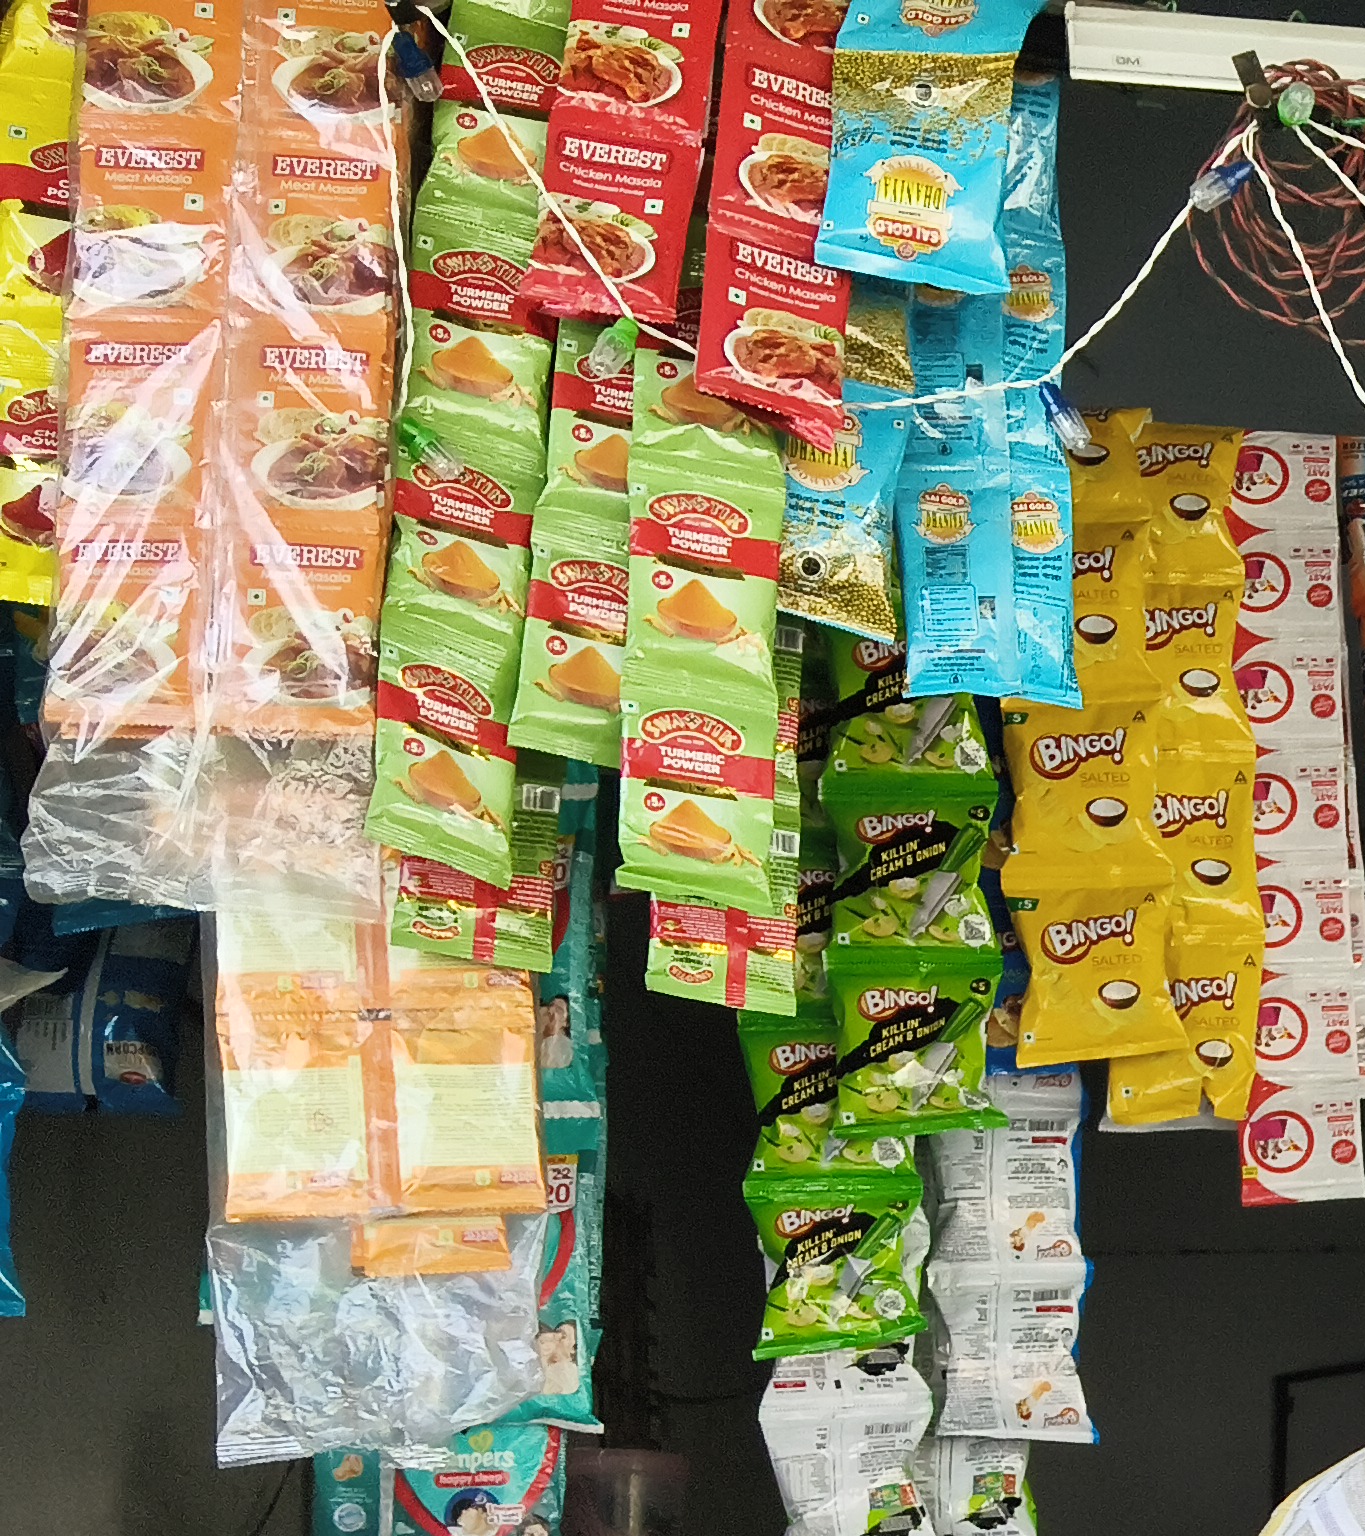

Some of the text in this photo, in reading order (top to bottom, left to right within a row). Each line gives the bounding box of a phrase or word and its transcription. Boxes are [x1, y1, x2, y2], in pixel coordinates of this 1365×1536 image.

[906, 9, 936, 22] GOLD
[481, 74, 545, 95] TURMERIC
[482, 85, 540, 102] POWDER
[749, 94, 802, 119] Chicken
[98, 148, 202, 171] EVEREST
[561, 137, 668, 172] EVEREST
[104, 171, 192, 186] Meat Masala
[274, 156, 378, 180] EVEREST
[559, 160, 663, 189] Chicken Masala
[279, 180, 368, 195] Meat Masala
[874, 218, 909, 237] GOLD
[735, 243, 838, 286] EVEREST
[450, 283, 515, 304] TURMERIC
[734, 267, 837, 304] Chicken Masala
[452, 294, 510, 313] POWDER
[88, 343, 190, 365] EVEREST
[263, 347, 367, 370] EVEREST
[429, 491, 496, 520] TURMERIC
[432, 504, 492, 527] POWDER
[666, 527, 733, 548] TURMERIC
[670, 539, 729, 556] POWDER
[77, 541, 180, 562] EVEREST
[254, 545, 360, 568] EVEREST
[417, 696, 480, 724] TURMERIC
[419, 706, 478, 733] POWDER
[658, 744, 726, 766] TURMERIC
[1037, 727, 1126, 770] BINGO!
[663, 756, 722, 776] POWDER
[1079, 771, 1131, 784] SALTED
[863, 809, 936, 837] BINGO!
[870, 858, 906, 881] CREAM
[1046, 908, 1136, 955] BINGO!
[1092, 953, 1143, 967] SALTED
[863, 985, 938, 1016] BINGO!
[869, 1033, 905, 1058] CREAM
[781, 1087, 815, 1110] CREAM
[780, 1203, 854, 1233] BINGO!
[830, 1229, 862, 1253] ONION
